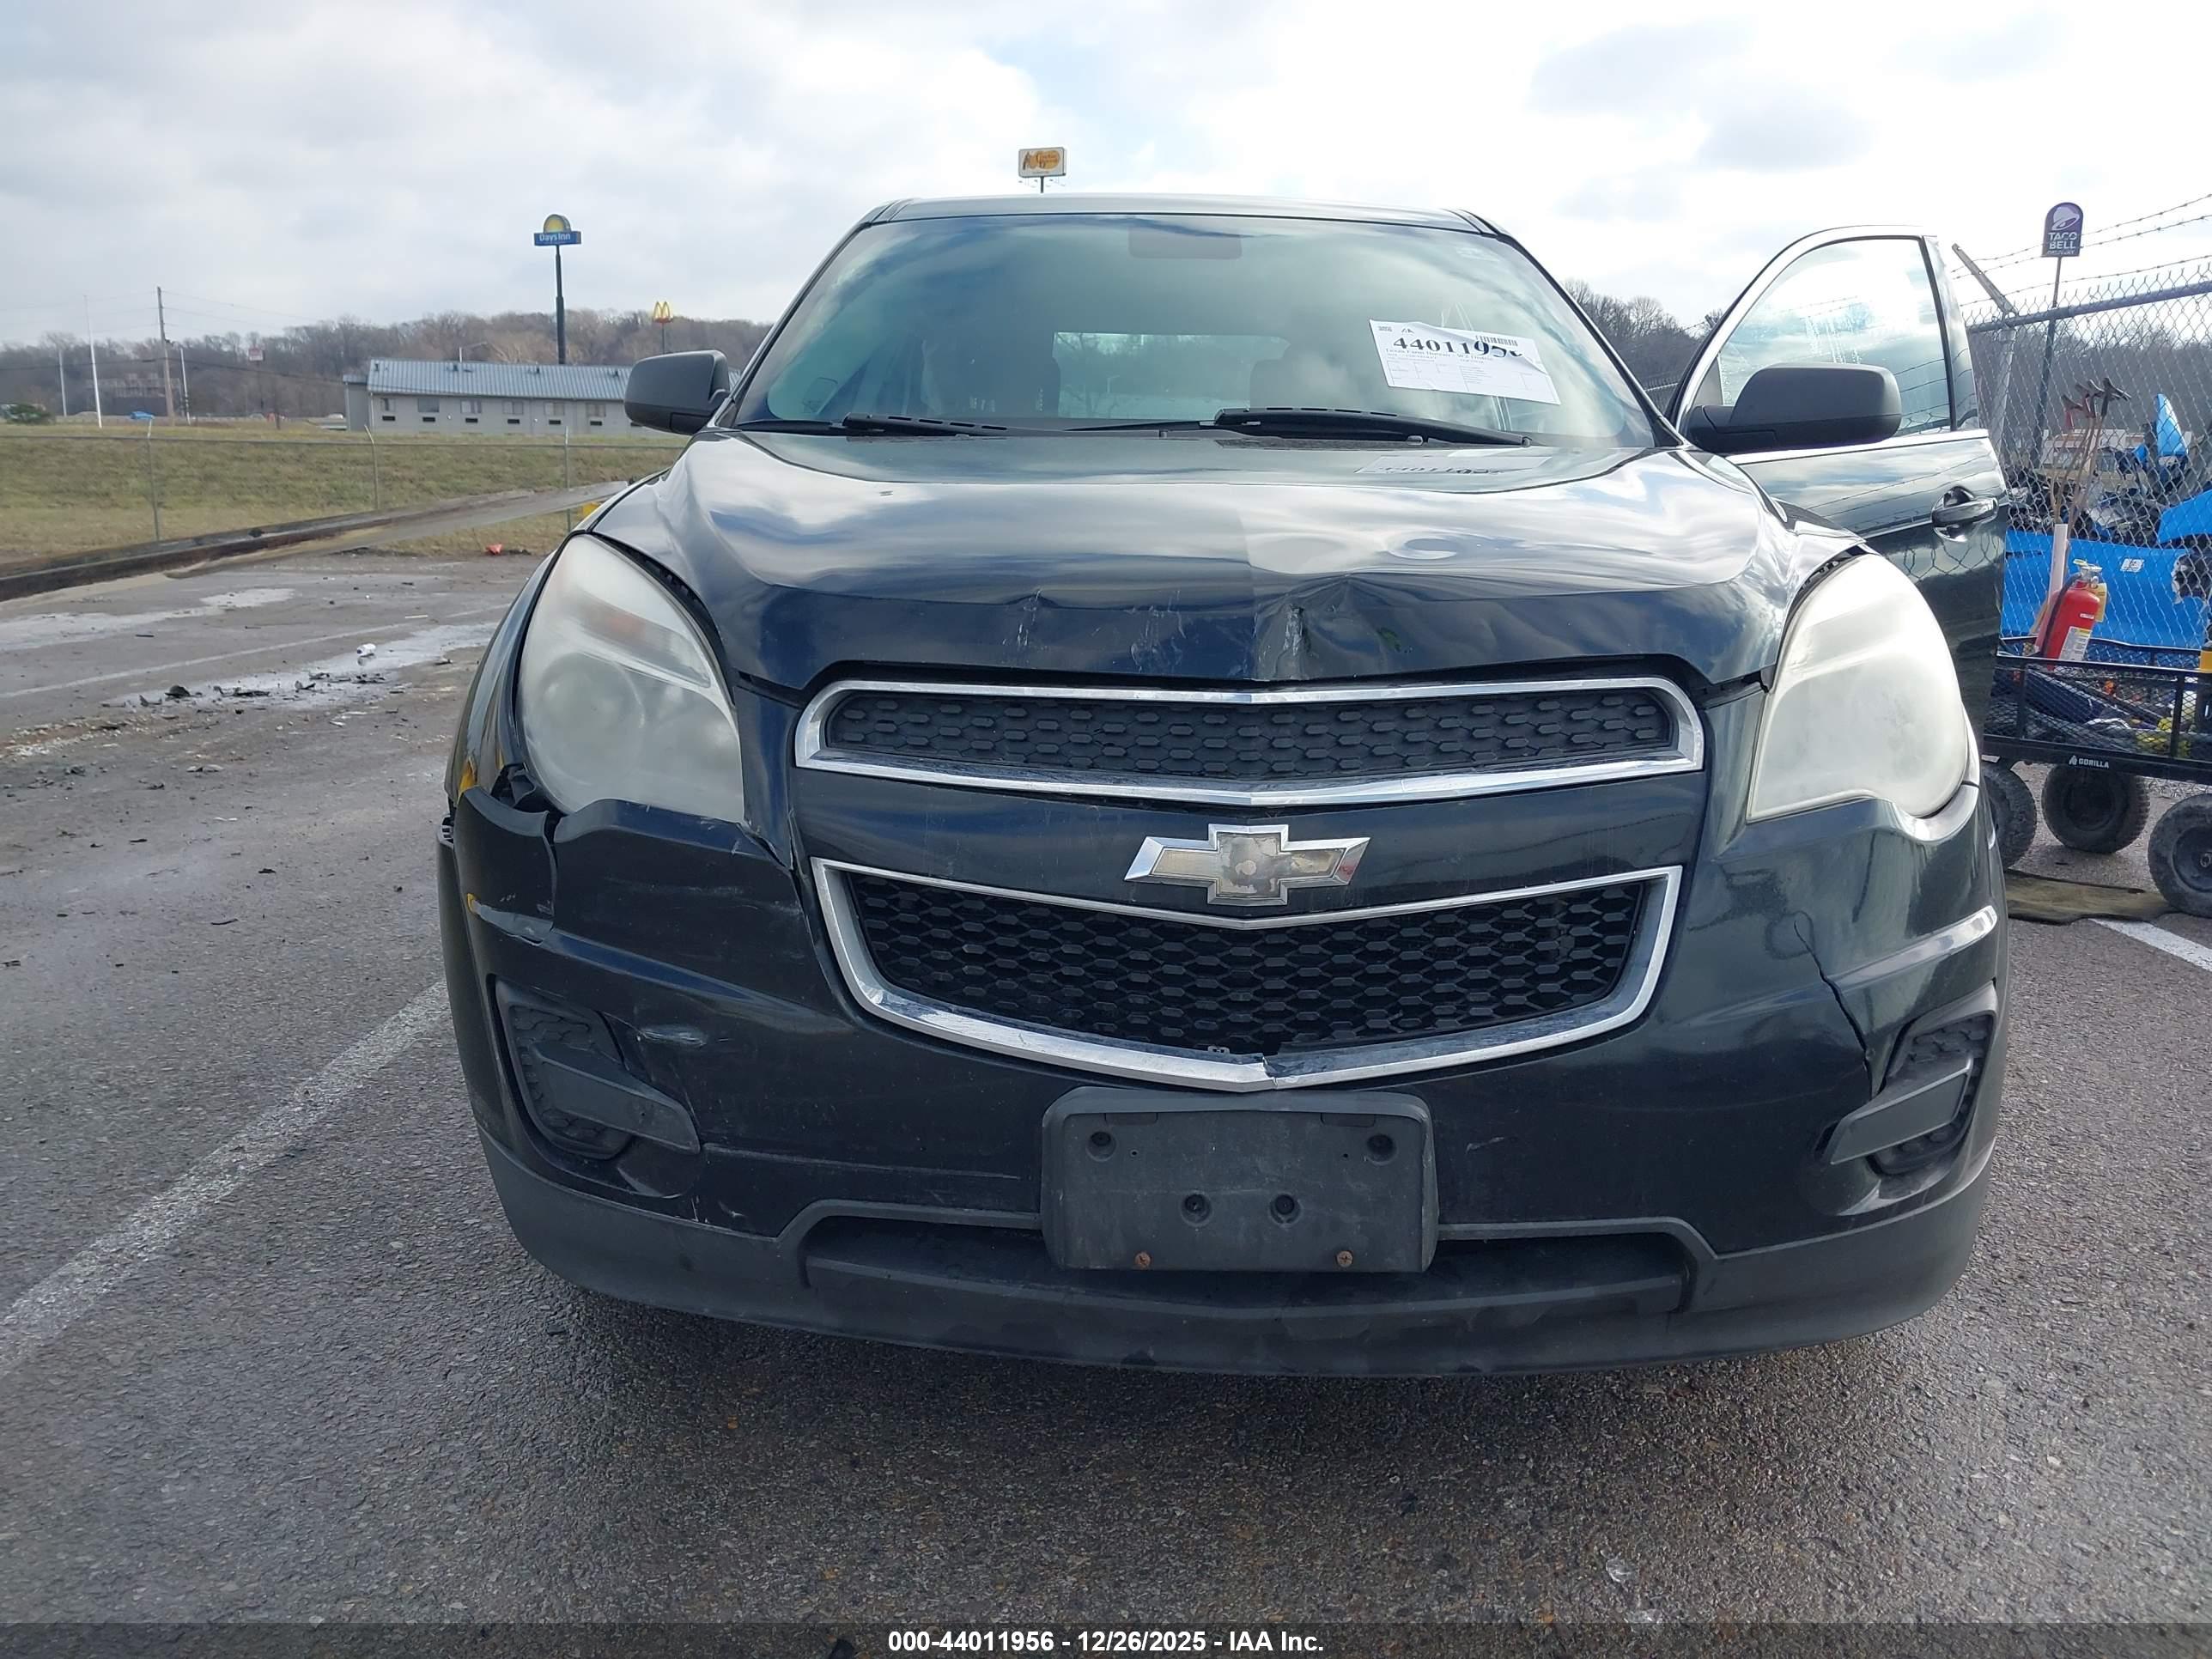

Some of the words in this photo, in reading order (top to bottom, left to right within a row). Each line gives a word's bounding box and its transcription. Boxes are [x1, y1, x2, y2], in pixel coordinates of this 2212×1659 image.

[2048, 232, 2077, 240] TACO
[2049, 240, 2076, 249] BELL
[2078, 757, 2110, 769] GORILLA
